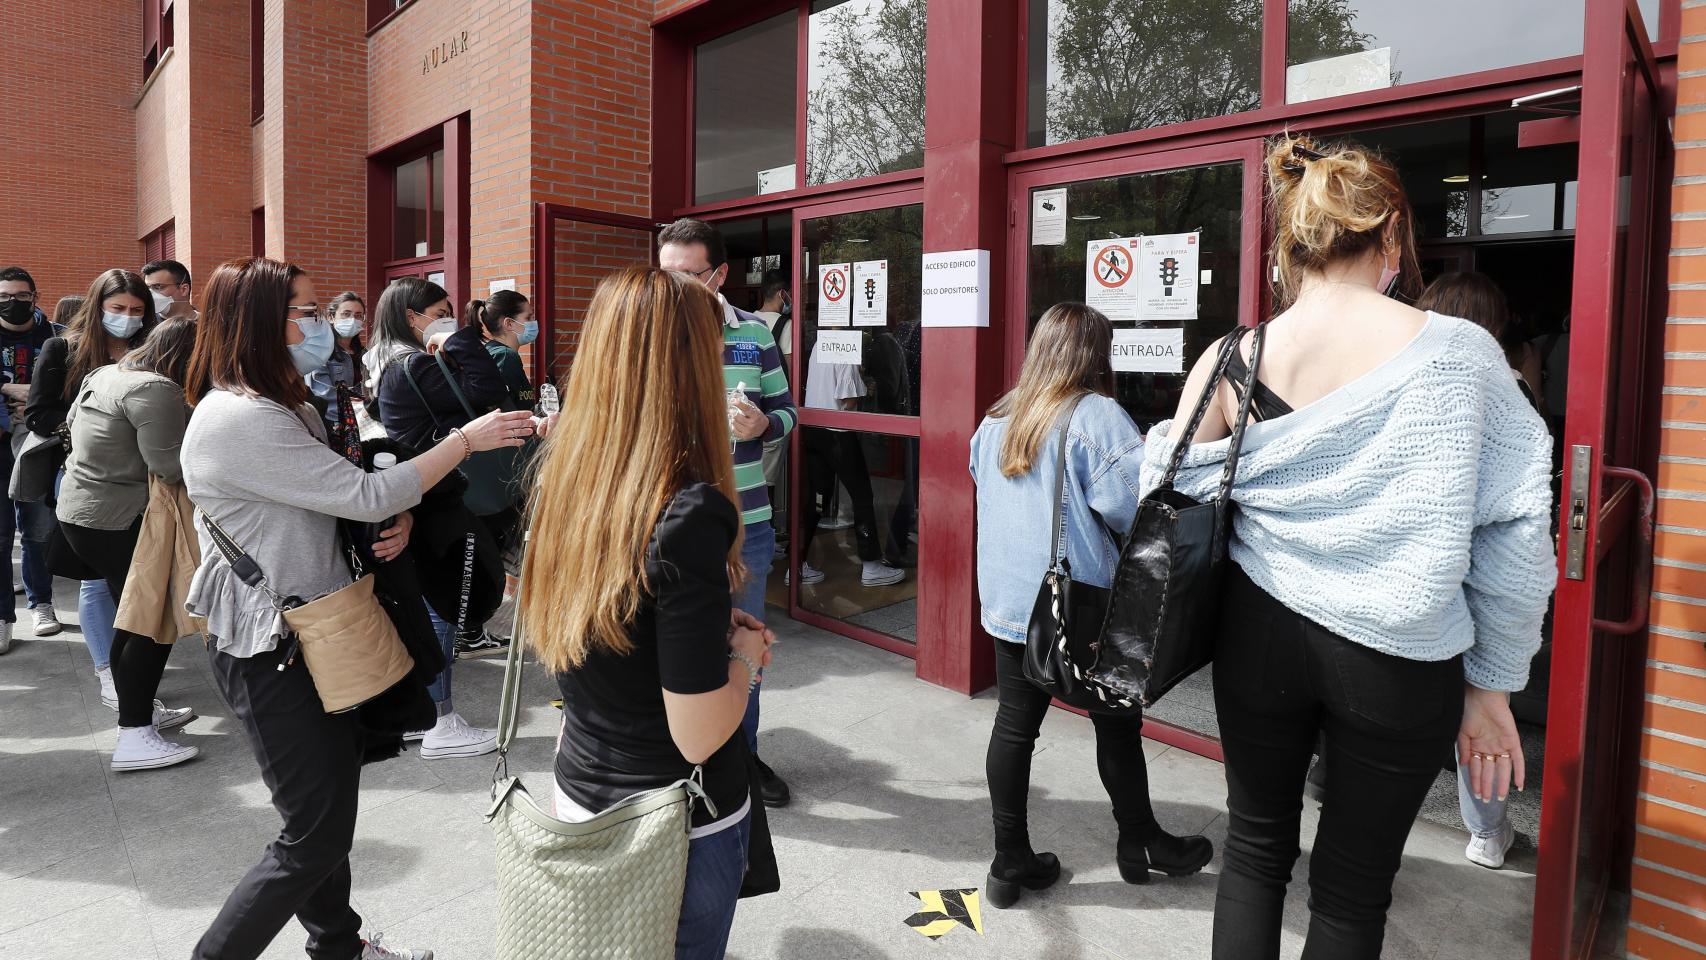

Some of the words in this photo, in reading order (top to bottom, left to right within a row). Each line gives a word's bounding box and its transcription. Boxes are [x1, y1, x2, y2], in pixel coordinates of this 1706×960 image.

[925, 262, 948, 270] ACCESO
[949, 260, 976, 269] EDIFICIO
[939, 286, 979, 295] OPOSITORES
[821, 342, 857, 353] ENTRADA
[1112, 344, 1174, 357] ENTRADA
